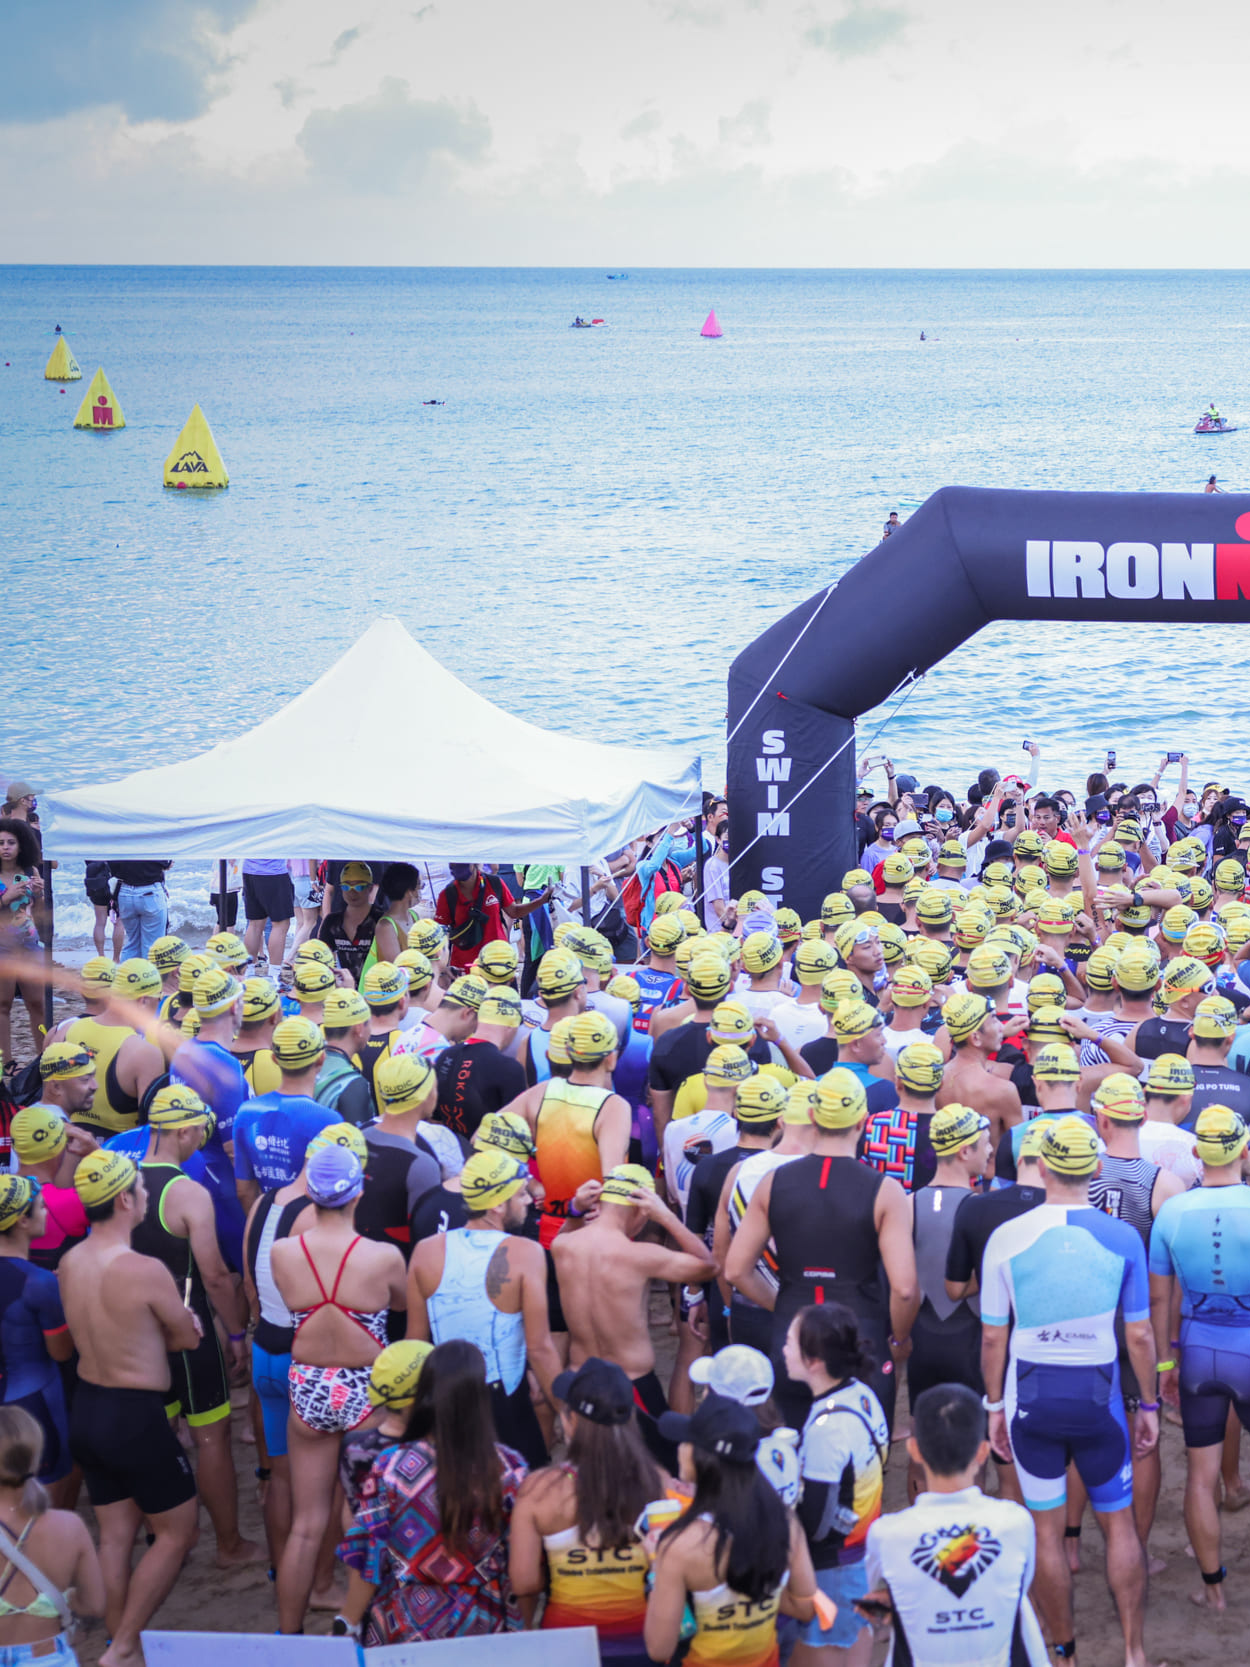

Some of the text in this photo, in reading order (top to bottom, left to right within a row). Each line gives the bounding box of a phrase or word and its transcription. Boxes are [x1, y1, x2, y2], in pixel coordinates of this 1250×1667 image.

[170, 462, 209, 472] LAVA
[756, 729, 792, 836] SWIM
[567, 1546, 633, 1564] STC
[718, 1596, 774, 1620] STC
[936, 1608, 984, 1624] STC
